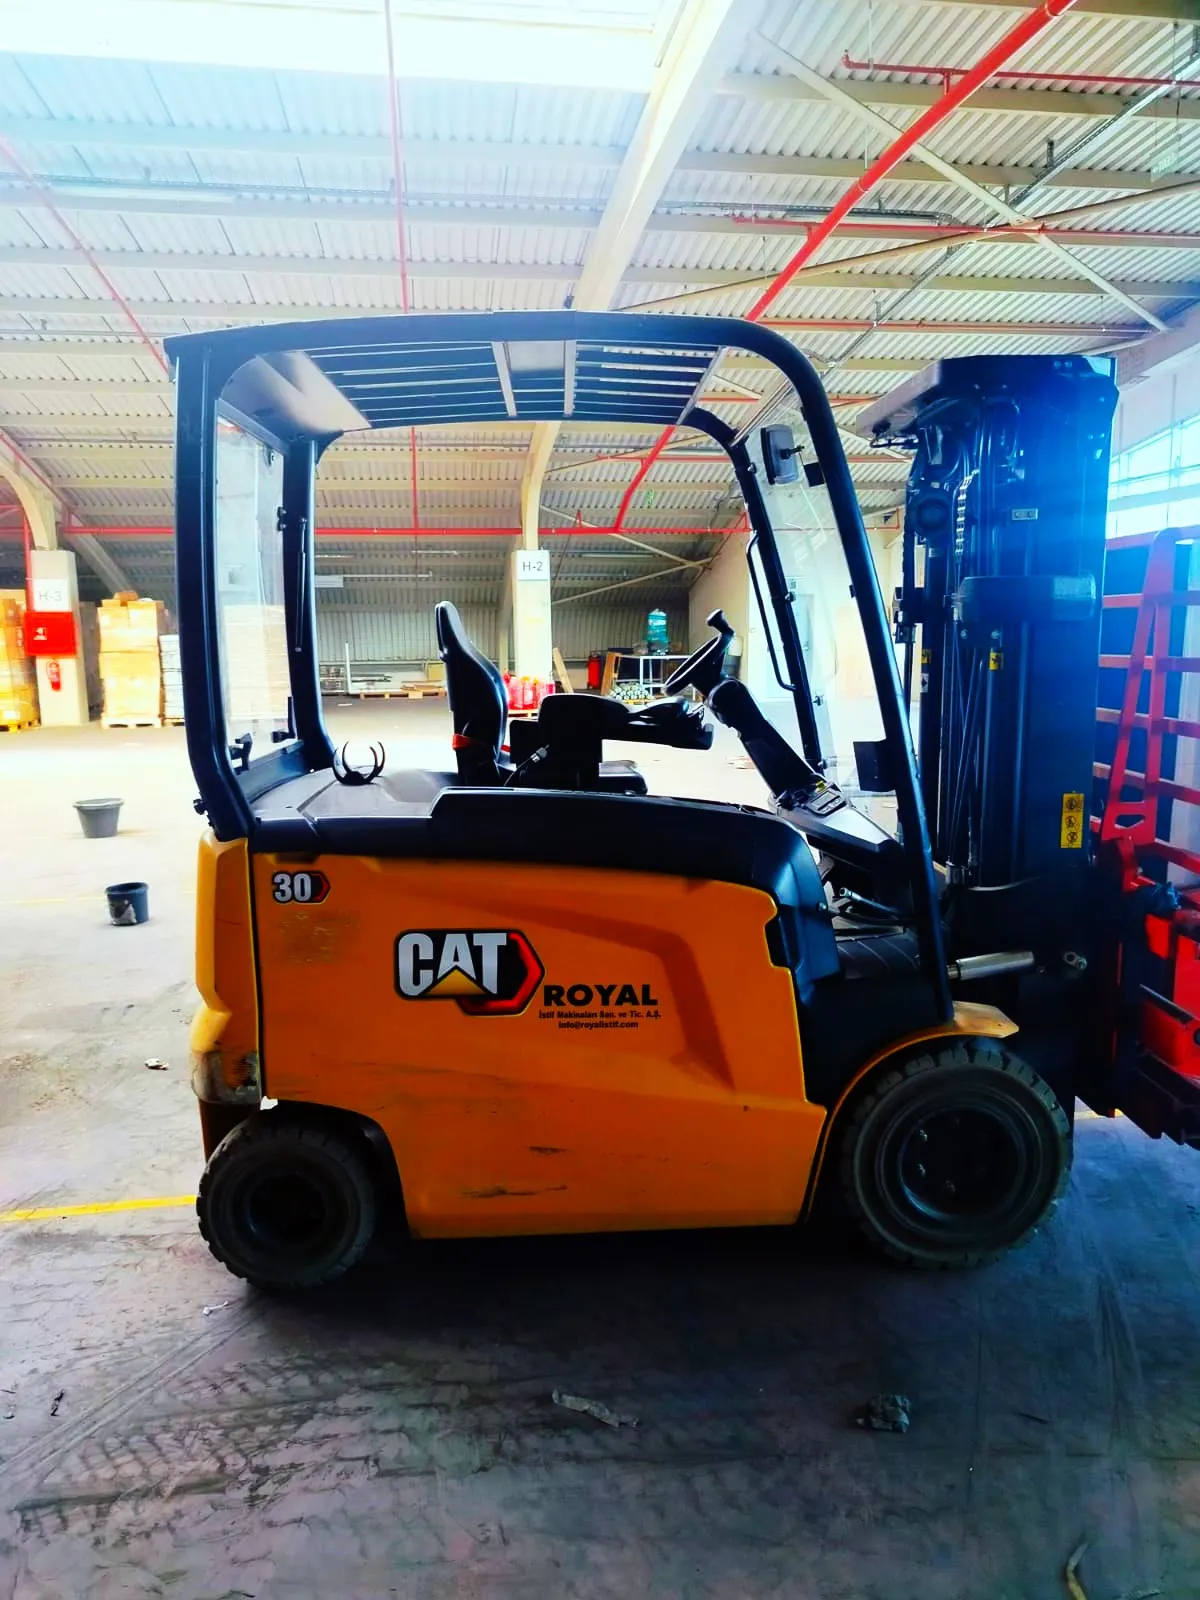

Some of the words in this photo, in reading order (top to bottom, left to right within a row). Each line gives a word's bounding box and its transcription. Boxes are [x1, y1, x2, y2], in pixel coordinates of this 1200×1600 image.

[522, 560, 543, 572] H-2
[39, 590, 62, 602] H-3
[274, 873, 312, 902] 30
[398, 932, 507, 996] CAT
[543, 984, 658, 1007] ROYAL
[599, 1010, 616, 1019] San.
[630, 1010, 644, 1019] Tic.
